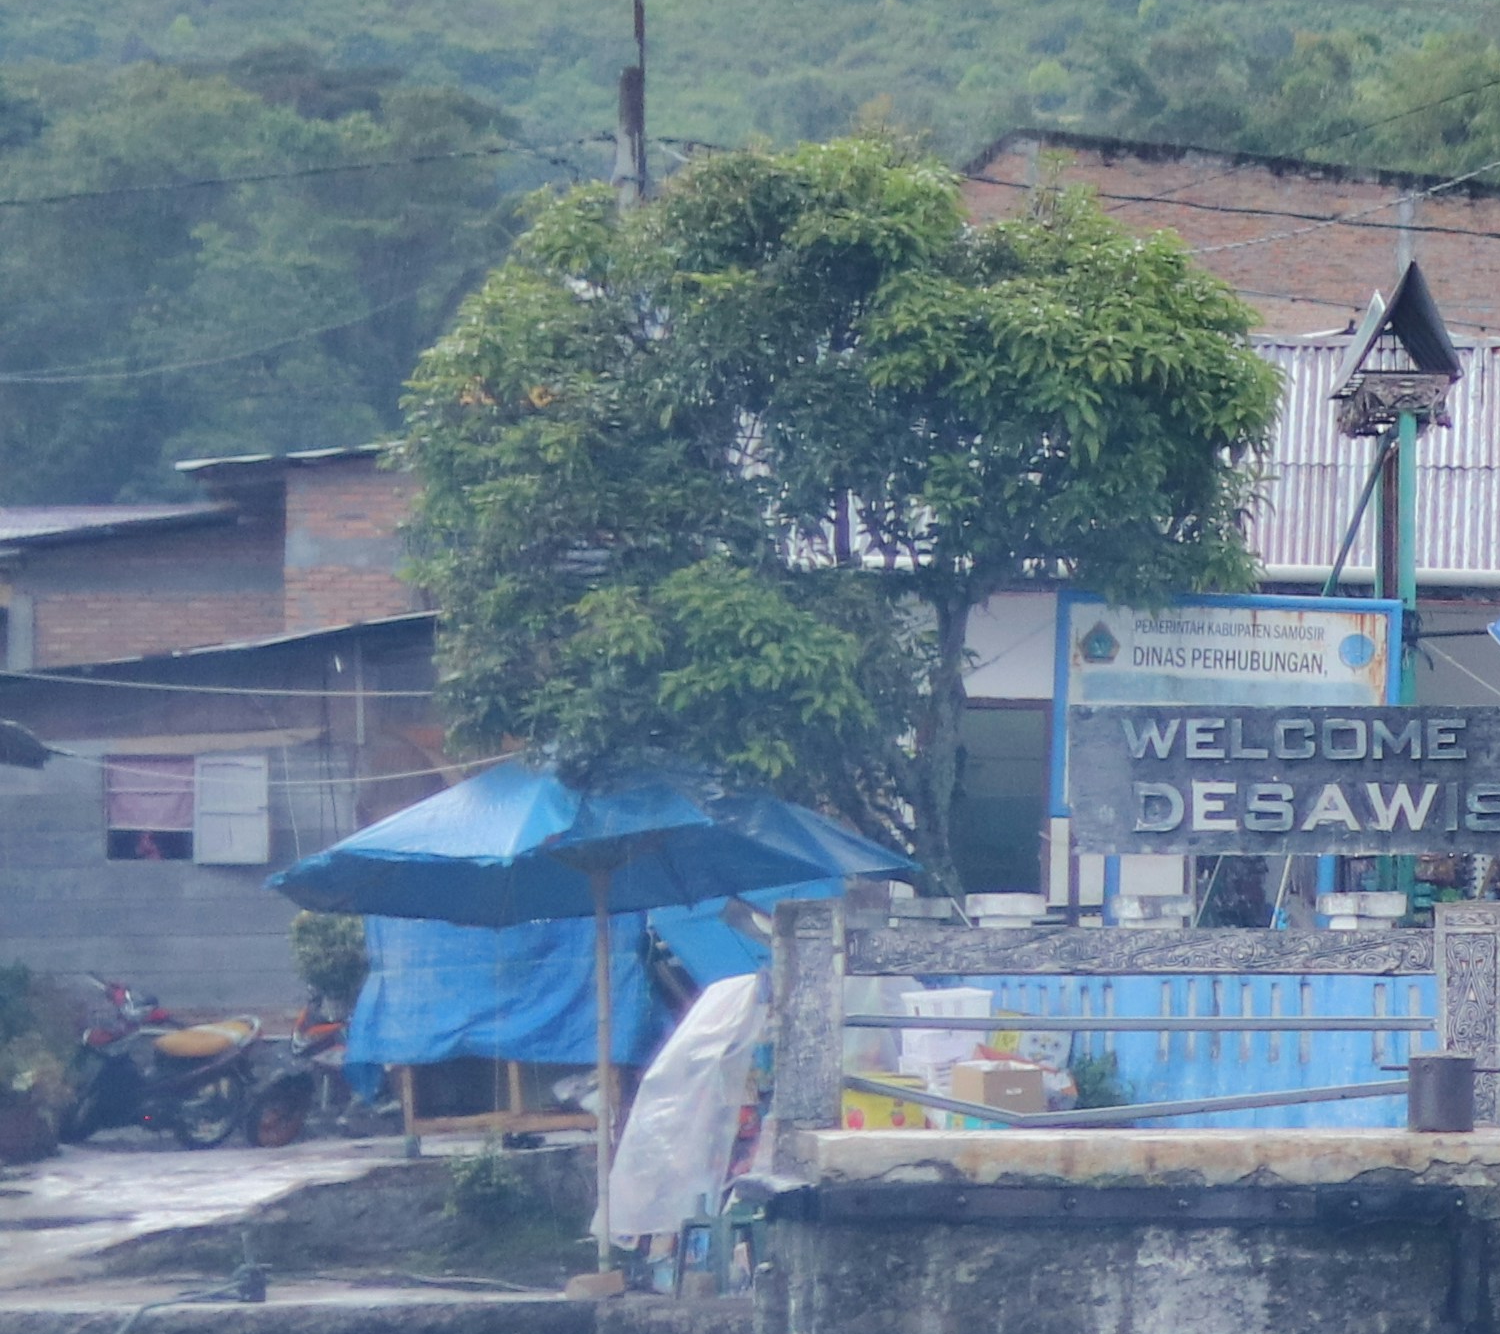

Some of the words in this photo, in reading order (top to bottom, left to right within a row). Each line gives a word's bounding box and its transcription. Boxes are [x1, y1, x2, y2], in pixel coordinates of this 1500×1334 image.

[1135, 619, 1204, 636] PEMERINTAH
[1207, 622, 1272, 639] KABUPATEN
[1274, 625, 1325, 642] SAMOSIR
[1133, 646, 1187, 668] DINAS
[1121, 718, 1468, 761] WELCOME
